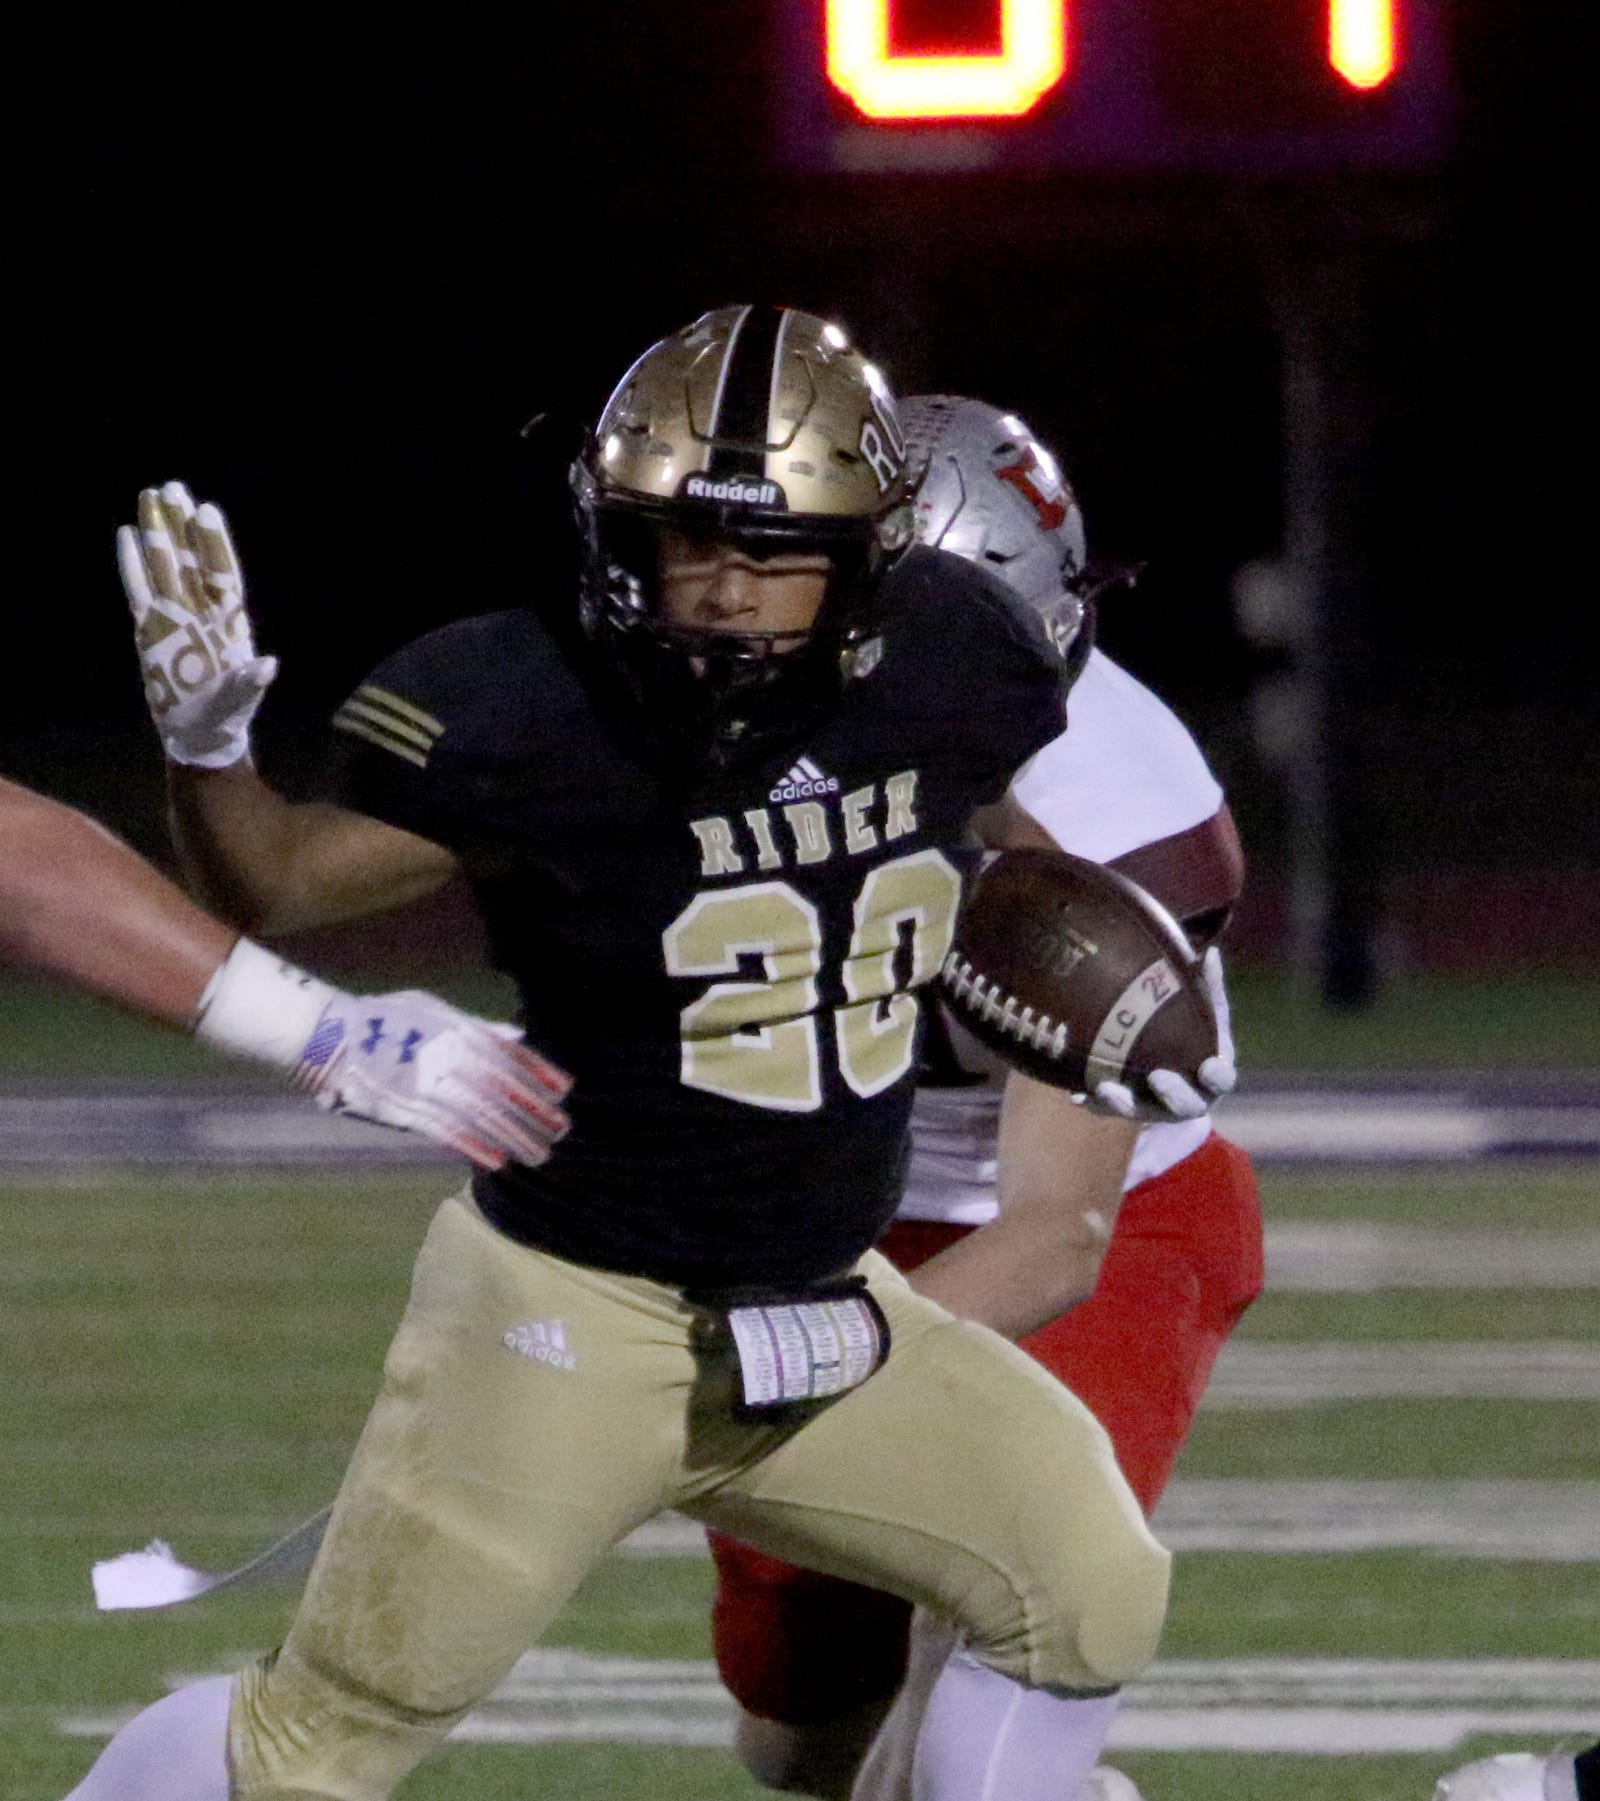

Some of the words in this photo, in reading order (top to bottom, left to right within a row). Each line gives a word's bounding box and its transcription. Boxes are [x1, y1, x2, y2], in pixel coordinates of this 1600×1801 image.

[686, 478, 776, 504] Riddell
[768, 777, 840, 802] adidas
[689, 769, 919, 876] RIDER
[661, 847, 962, 1113] 20
[503, 1331, 578, 1371] adidas
